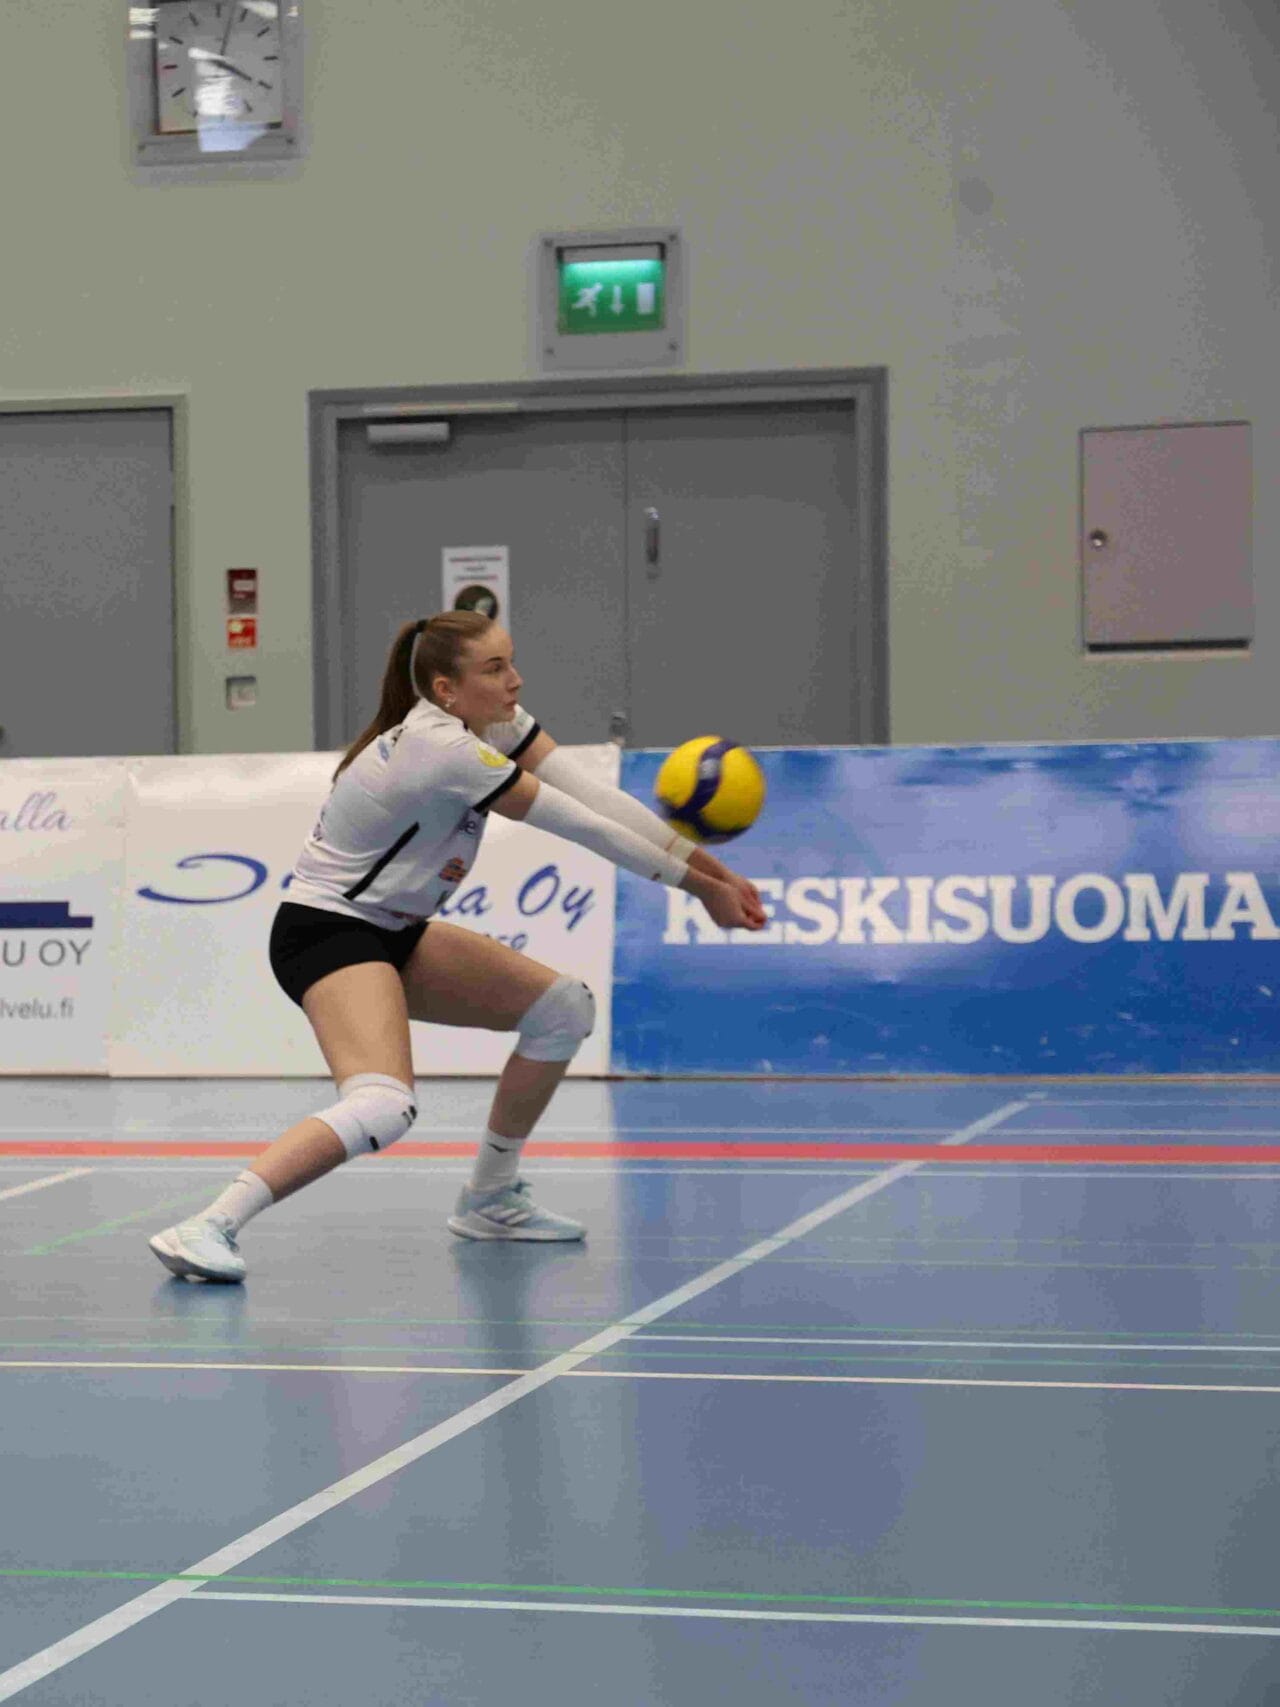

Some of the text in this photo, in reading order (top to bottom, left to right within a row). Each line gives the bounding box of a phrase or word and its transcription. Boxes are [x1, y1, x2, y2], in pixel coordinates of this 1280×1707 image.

[517, 864, 594, 931] Oy
[663, 873, 1280, 944] KESKISUOMA
[38, 939, 92, 968] OY
